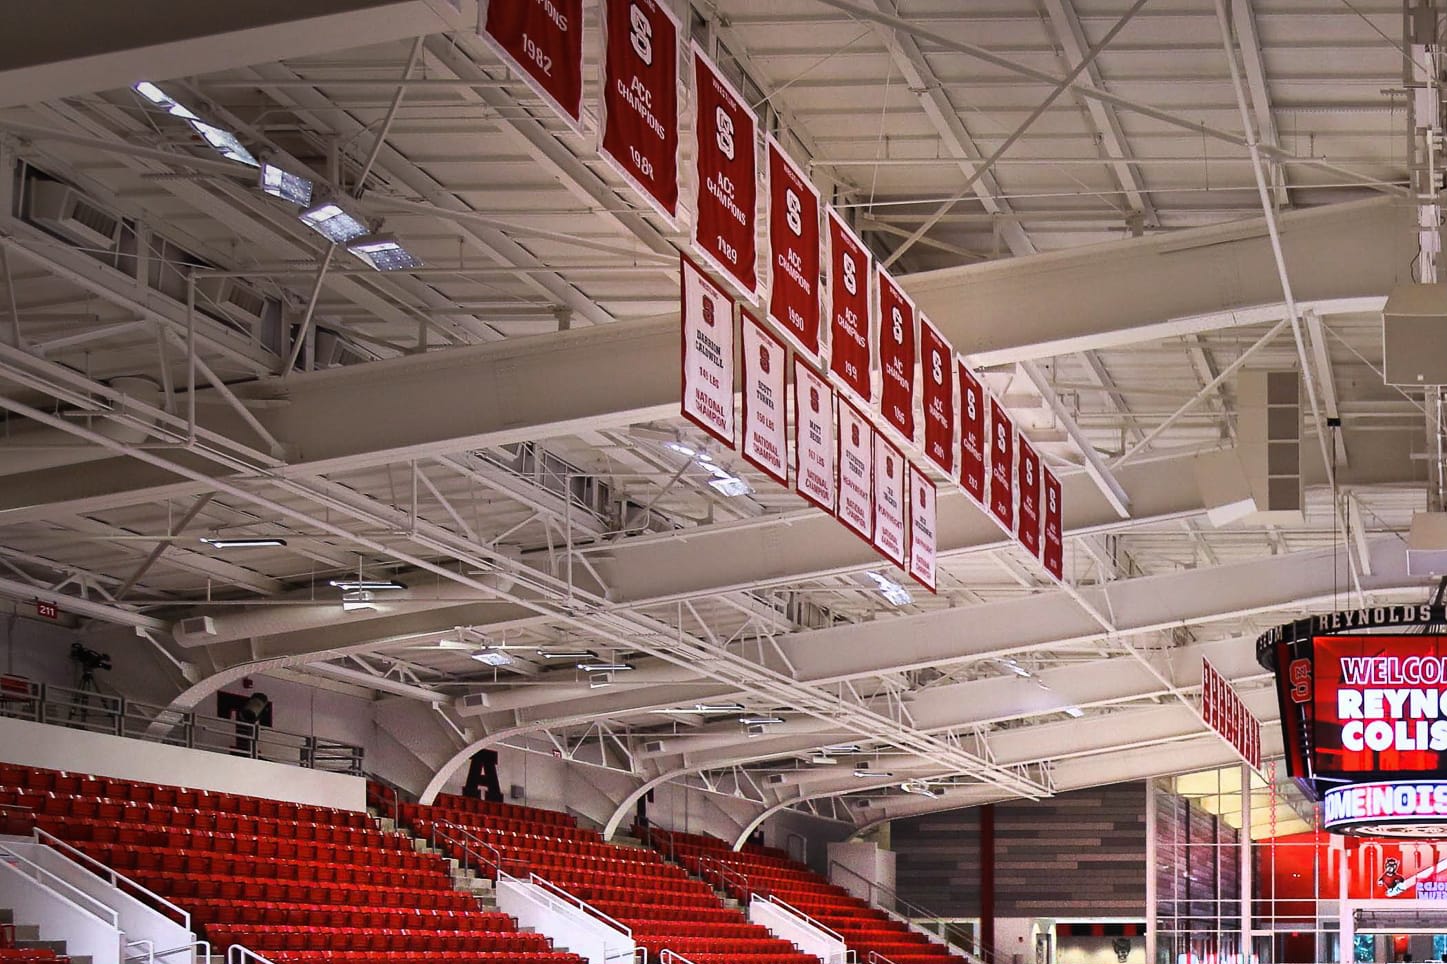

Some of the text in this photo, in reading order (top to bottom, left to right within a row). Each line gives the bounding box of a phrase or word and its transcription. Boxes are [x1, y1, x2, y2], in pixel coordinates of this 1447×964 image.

[522, 33, 553, 77] 1982
[630, 75, 653, 109] ACC
[718, 172, 735, 200] ACC
[787, 248, 802, 272] ACC
[39, 605, 55, 616] 211
[1319, 604, 1432, 631] REYNOLDS
[462, 748, 504, 804] A
